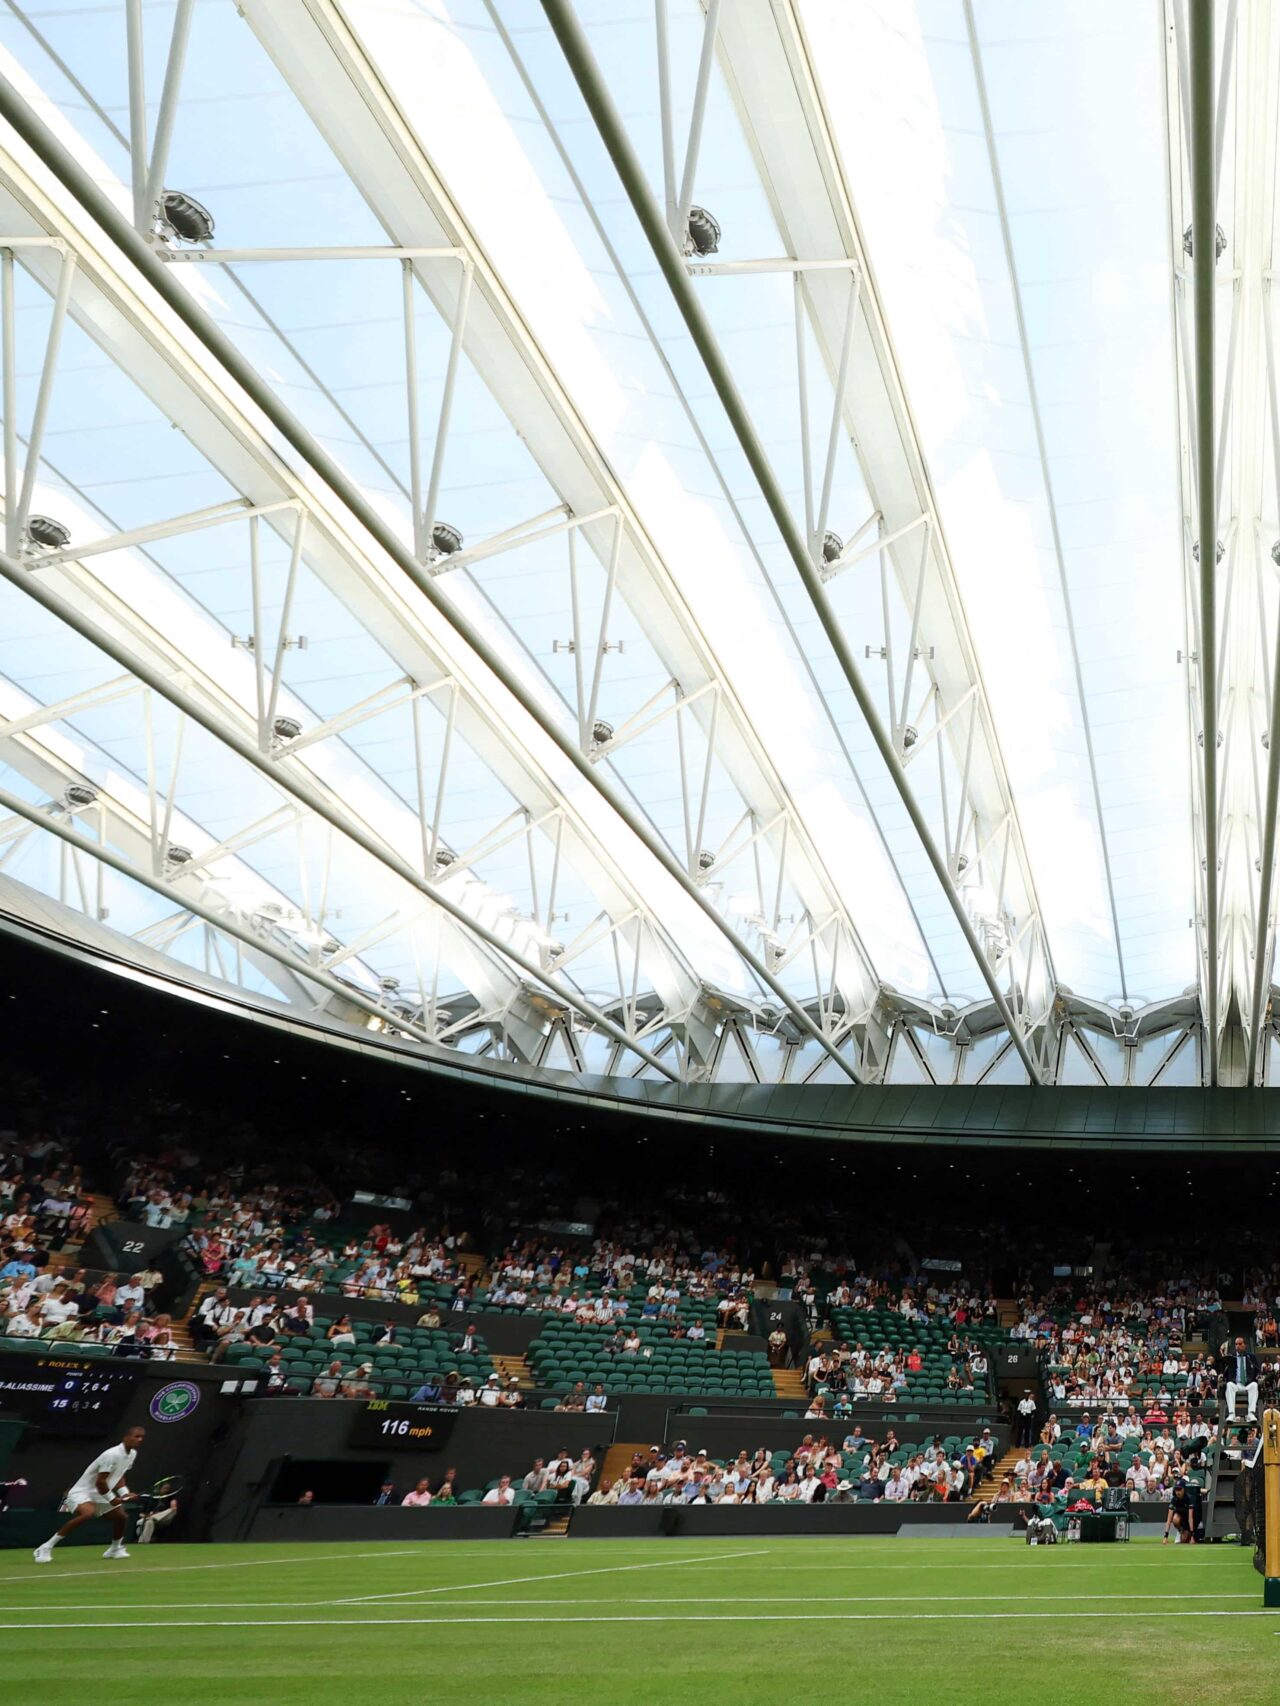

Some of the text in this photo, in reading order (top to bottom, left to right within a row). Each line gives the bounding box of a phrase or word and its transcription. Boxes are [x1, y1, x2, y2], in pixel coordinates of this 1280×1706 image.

[122, 1241, 145, 1253] 22
[770, 1312, 782, 1321] 24
[48, 1361, 80, 1369] ROLEX
[64, 1381, 75, 1390] 0
[91, 1383, 99, 1391] 6
[101, 1383, 110, 1392] 4
[52, 1399, 68, 1408] 15
[91, 1402, 101, 1410] 4
[367, 1400, 390, 1411] IBM
[381, 1419, 433, 1438] 116 mph
